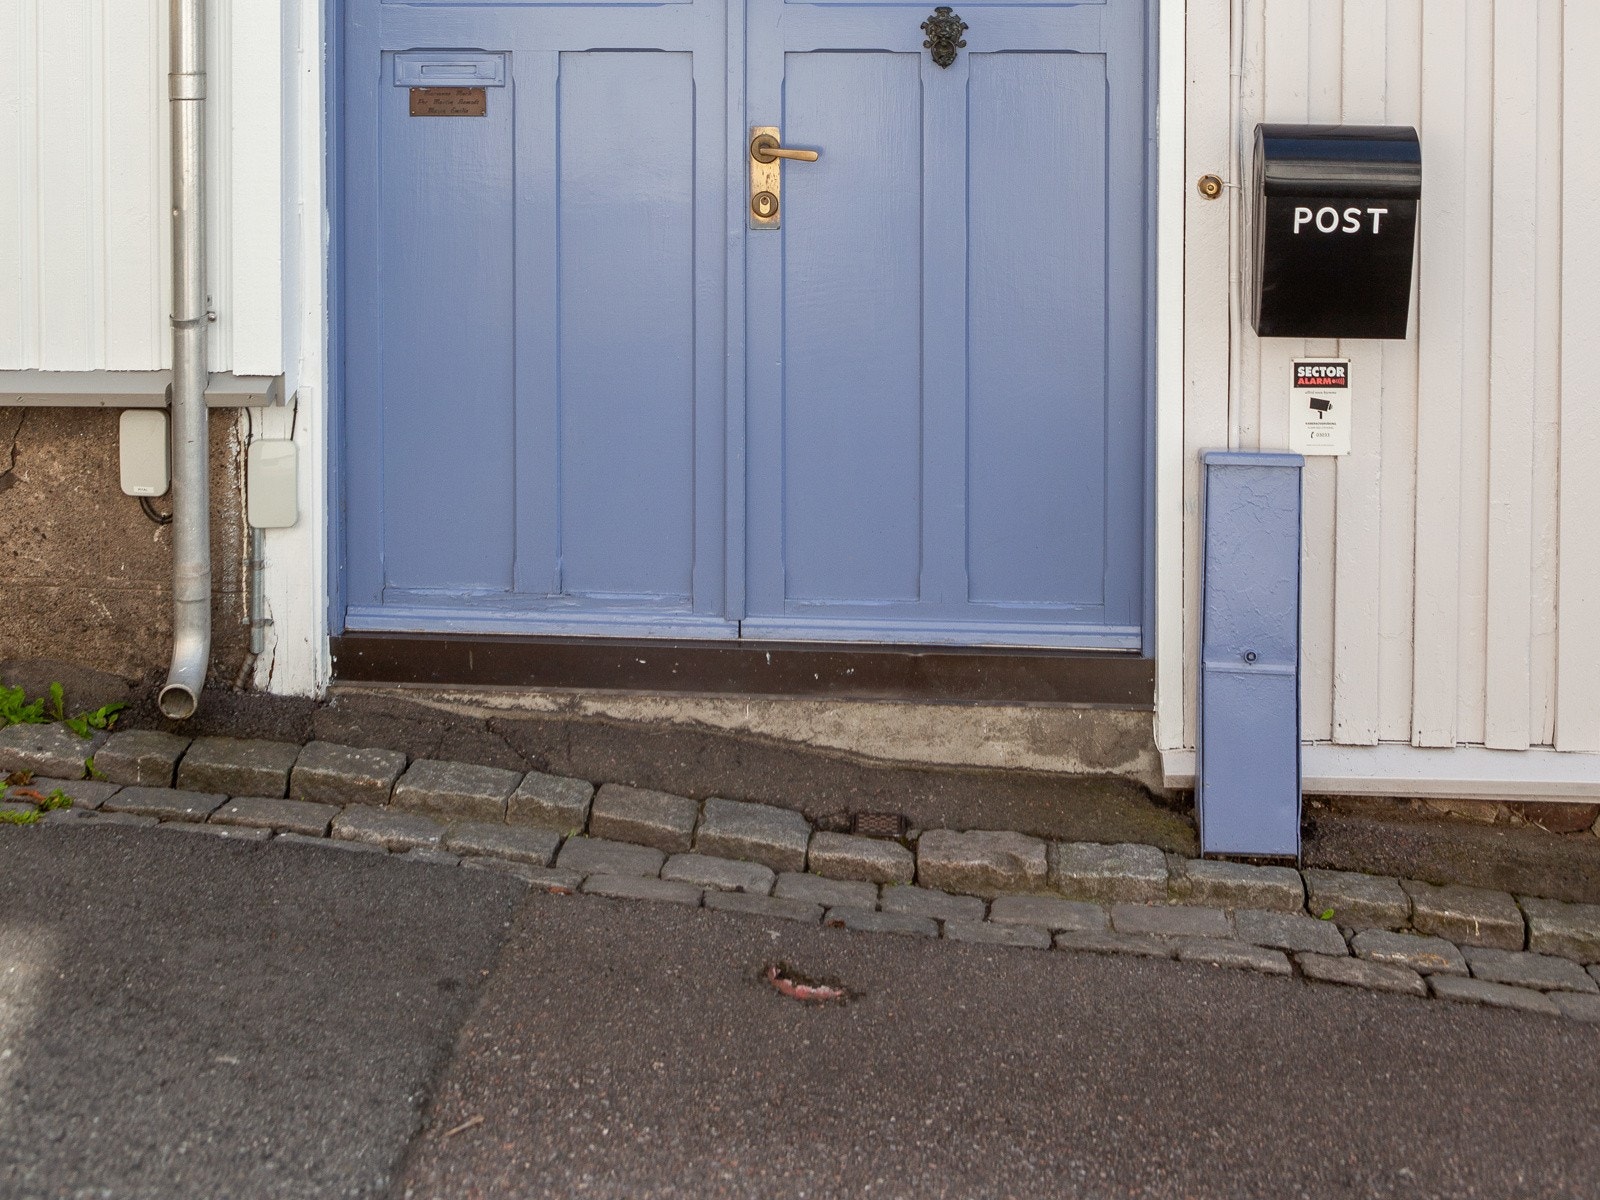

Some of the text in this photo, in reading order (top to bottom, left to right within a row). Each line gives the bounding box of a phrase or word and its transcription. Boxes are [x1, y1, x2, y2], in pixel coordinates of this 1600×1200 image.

[1294, 207, 1388, 234] POST
[1297, 366, 1345, 377] SECTOR
[1297, 377, 1332, 385] ALARM
